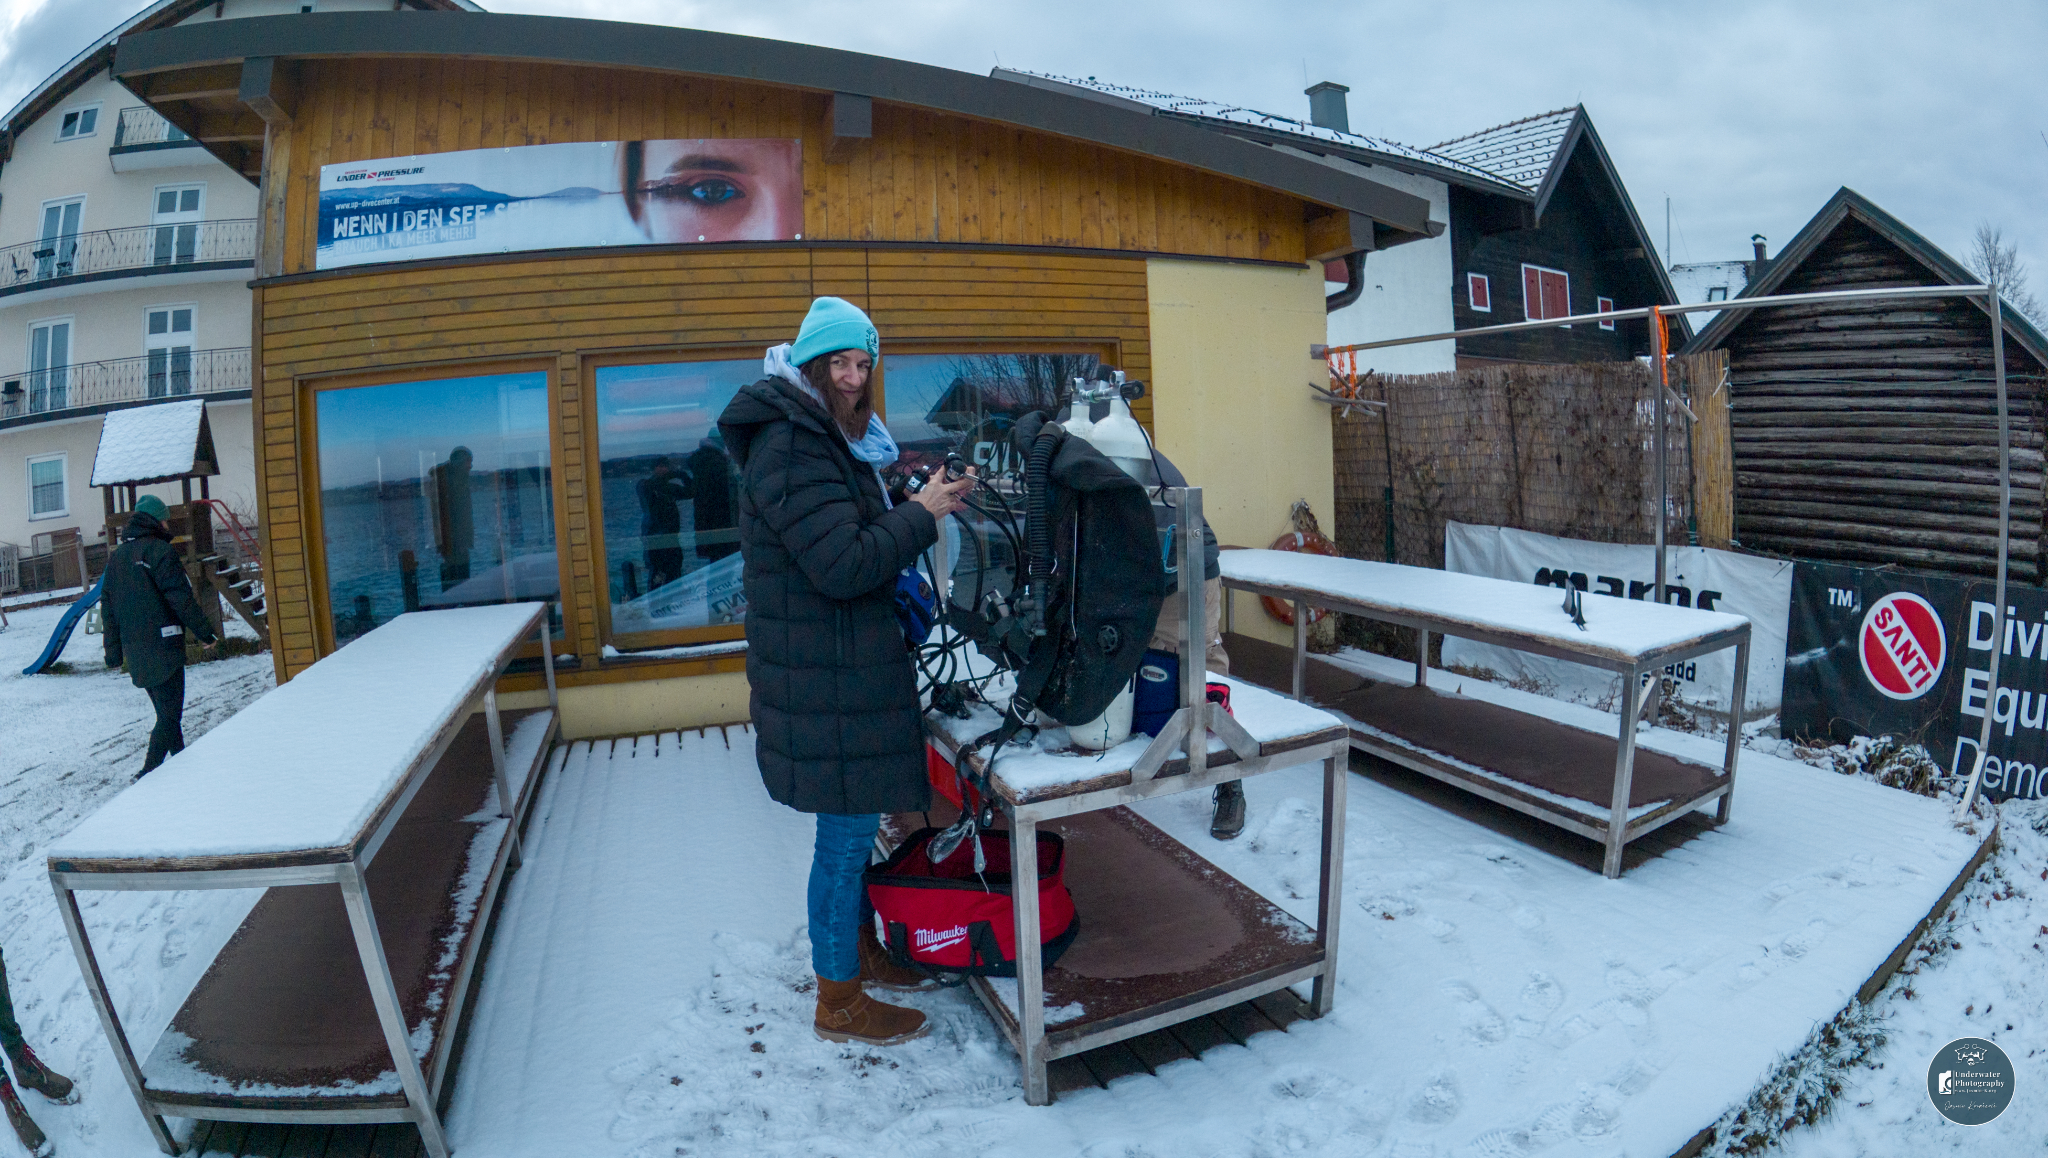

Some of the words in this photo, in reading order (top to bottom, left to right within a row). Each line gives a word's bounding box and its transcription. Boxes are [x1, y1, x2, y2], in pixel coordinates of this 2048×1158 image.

[336, 173, 366, 182] UNDER
[378, 167, 425, 177] PRESSURE
[335, 197, 400, 210] www.up-divecenter.at
[333, 213, 387, 238] WENN
[403, 207, 443, 231] DEN
[448, 204, 488, 225] SEE
[335, 237, 377, 254] BRAUCH
[389, 234, 402, 248] KA
[407, 230, 436, 245] MEER
[440, 225, 474, 241] MEHR!
[1828, 588, 1853, 607] TM
[1874, 607, 1932, 689] SANTI
[1961, 668, 2048, 736] Equ
